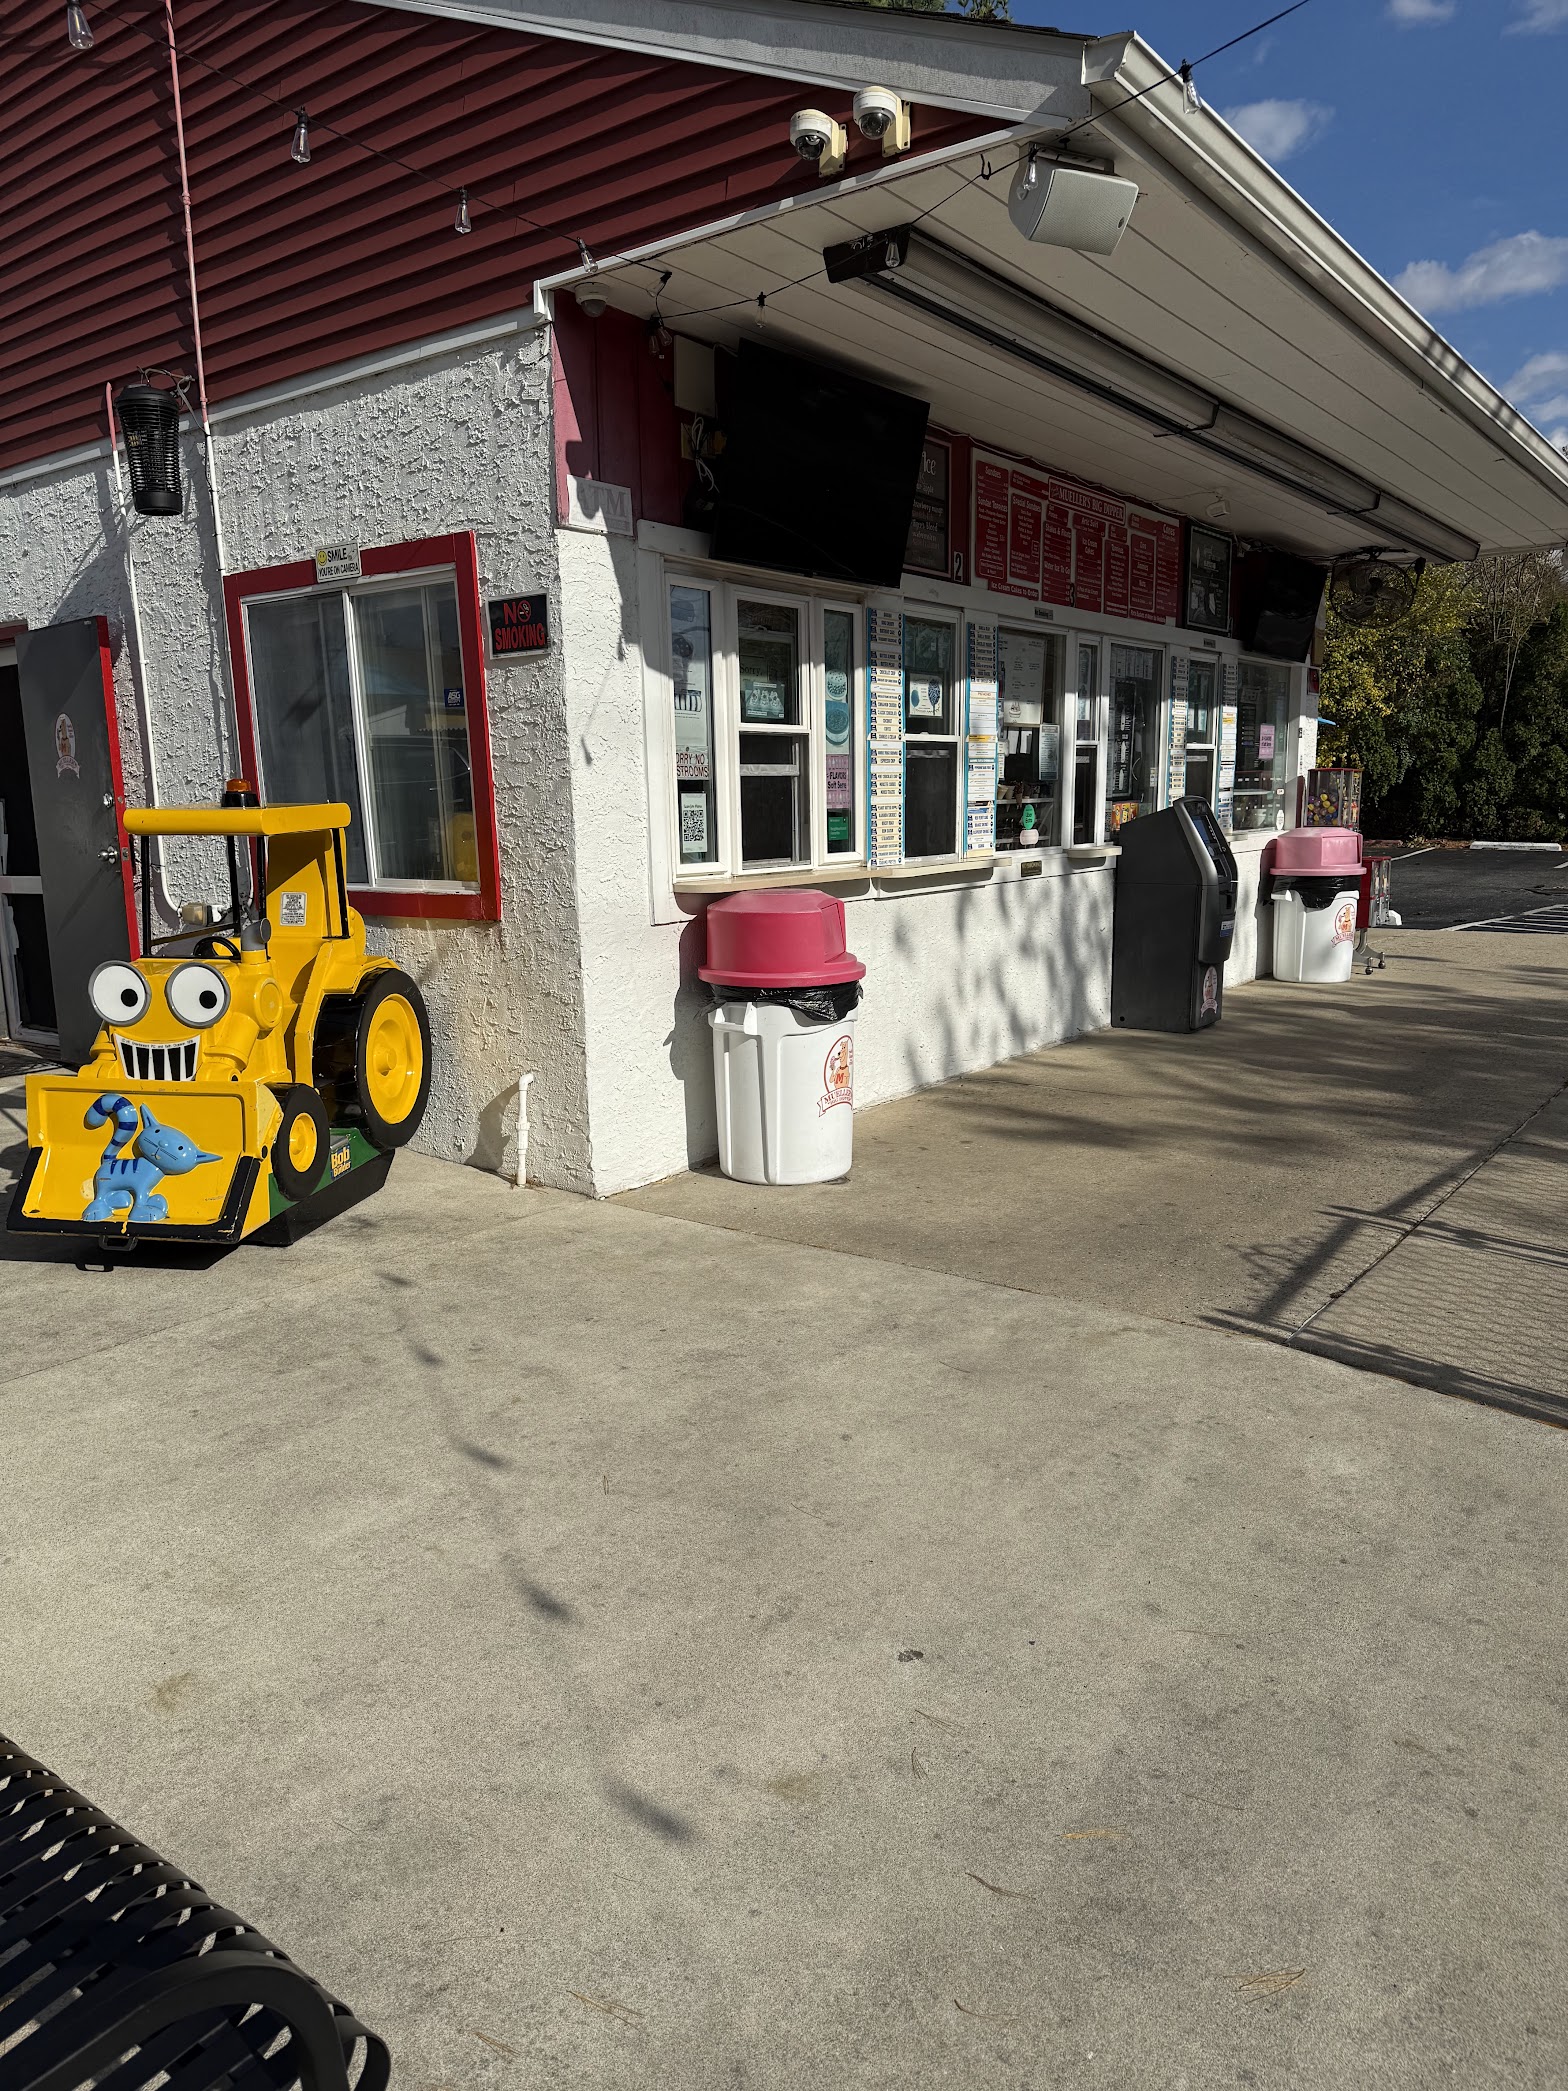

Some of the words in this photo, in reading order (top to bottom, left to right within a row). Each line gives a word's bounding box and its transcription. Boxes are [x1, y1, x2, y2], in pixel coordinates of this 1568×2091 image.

[570, 481, 628, 517] ATM
[1059, 487, 1091, 508] MUELLER'S
[1092, 499, 1103, 513] BIG
[1103, 503, 1123, 519] DIPPER
[327, 548, 348, 562] SMILE
[955, 553, 962, 580] 2
[333, 565, 340, 575] ON
[340, 562, 359, 574] CAMERA
[503, 600, 531, 625] NO
[495, 623, 546, 651] SMOKING
[695, 754, 705, 764] NO
[835, 1073, 844, 1084] M
[331, 1146, 350, 1170] Bob
